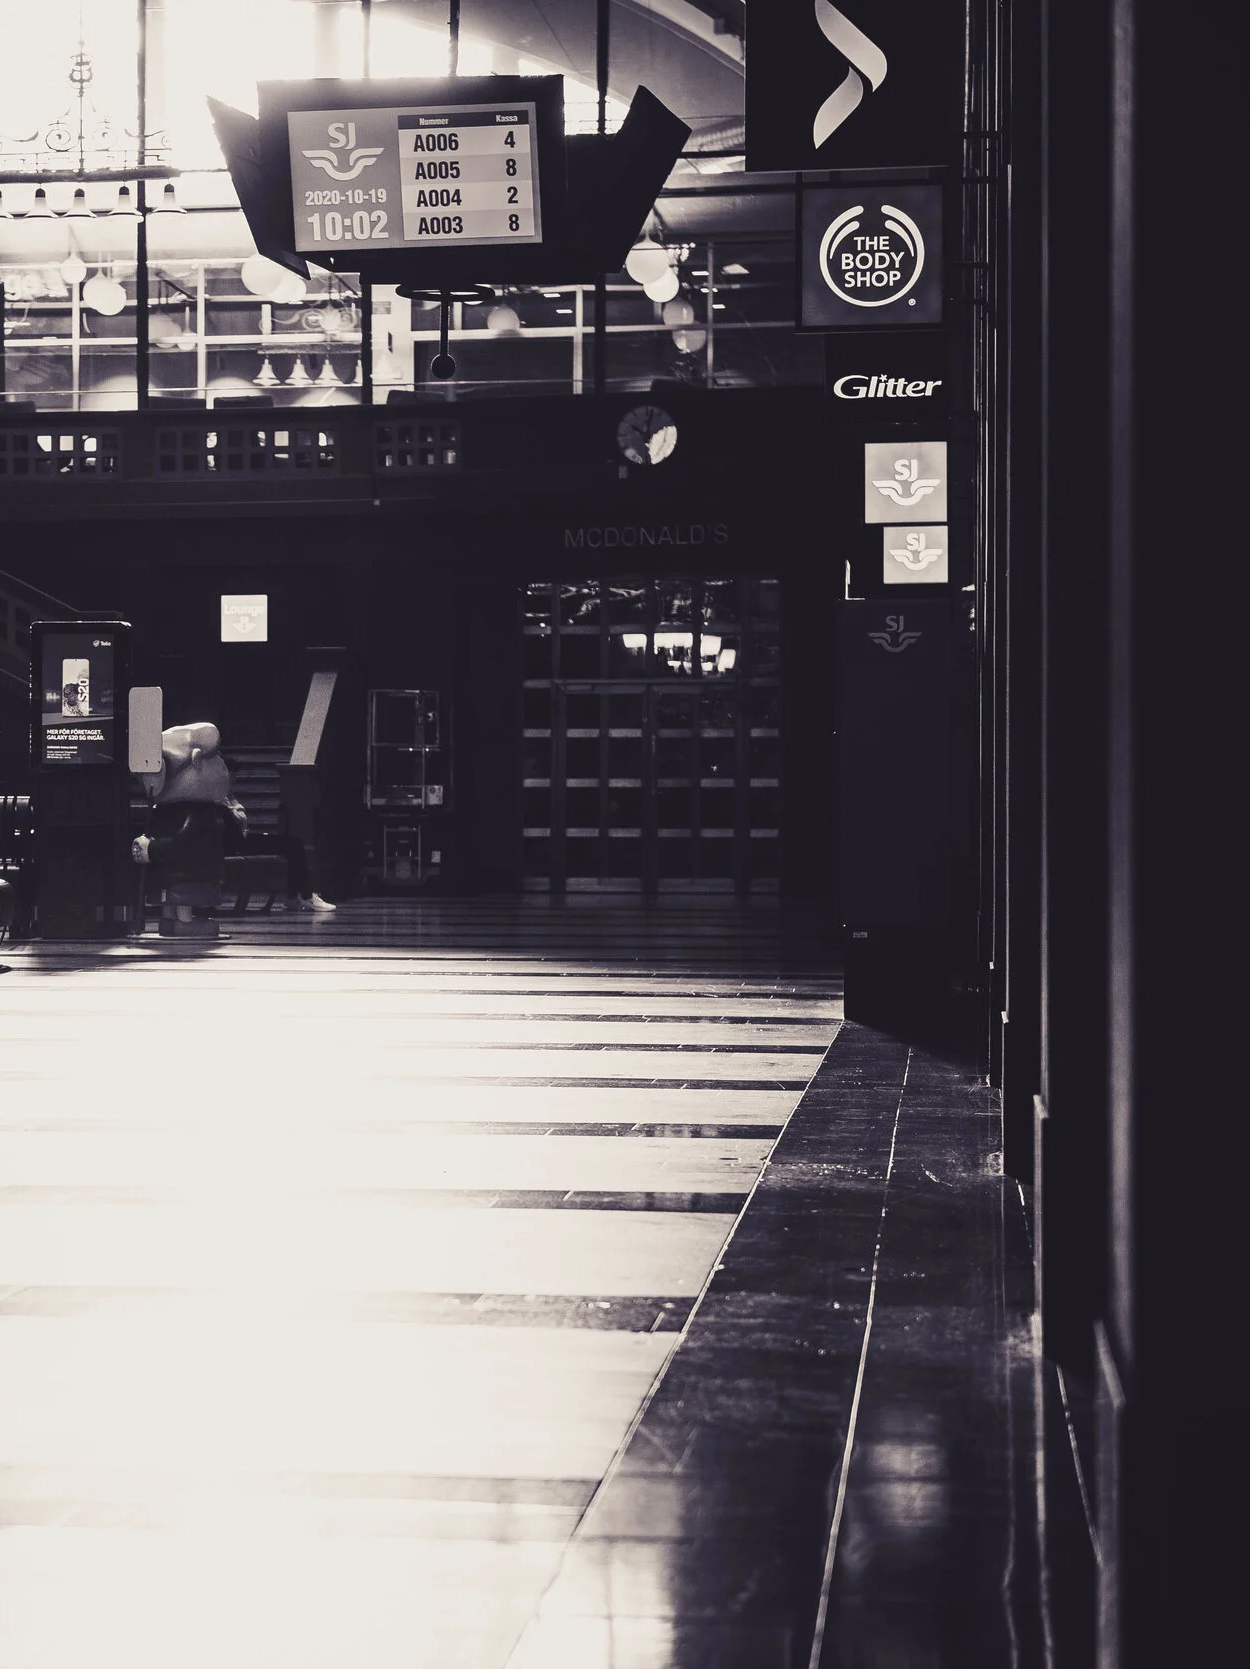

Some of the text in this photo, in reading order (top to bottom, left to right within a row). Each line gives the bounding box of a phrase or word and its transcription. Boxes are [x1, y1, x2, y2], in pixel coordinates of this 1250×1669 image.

[419, 114, 518, 126] Nummer Kassa
[327, 122, 356, 149] SJ
[413, 131, 516, 152] A006 4
[415, 158, 517, 180] A005 8
[305, 188, 387, 206] 2020-10-19
[416, 186, 519, 208] A004 2
[307, 210, 389, 241] 10:02
[418, 213, 520, 235] A003 8
[853, 236, 890, 251] THE
[841, 252, 905, 270] BODY
[844, 270, 901, 288] SHOP
[833, 373, 942, 399] Glitter
[893, 458, 919, 482] SJ
[564, 523, 729, 548] MCDONALD'S
[906, 532, 927, 552] SJ
[885, 615, 905, 632] SJ
[77, 678, 89, 702] S20
